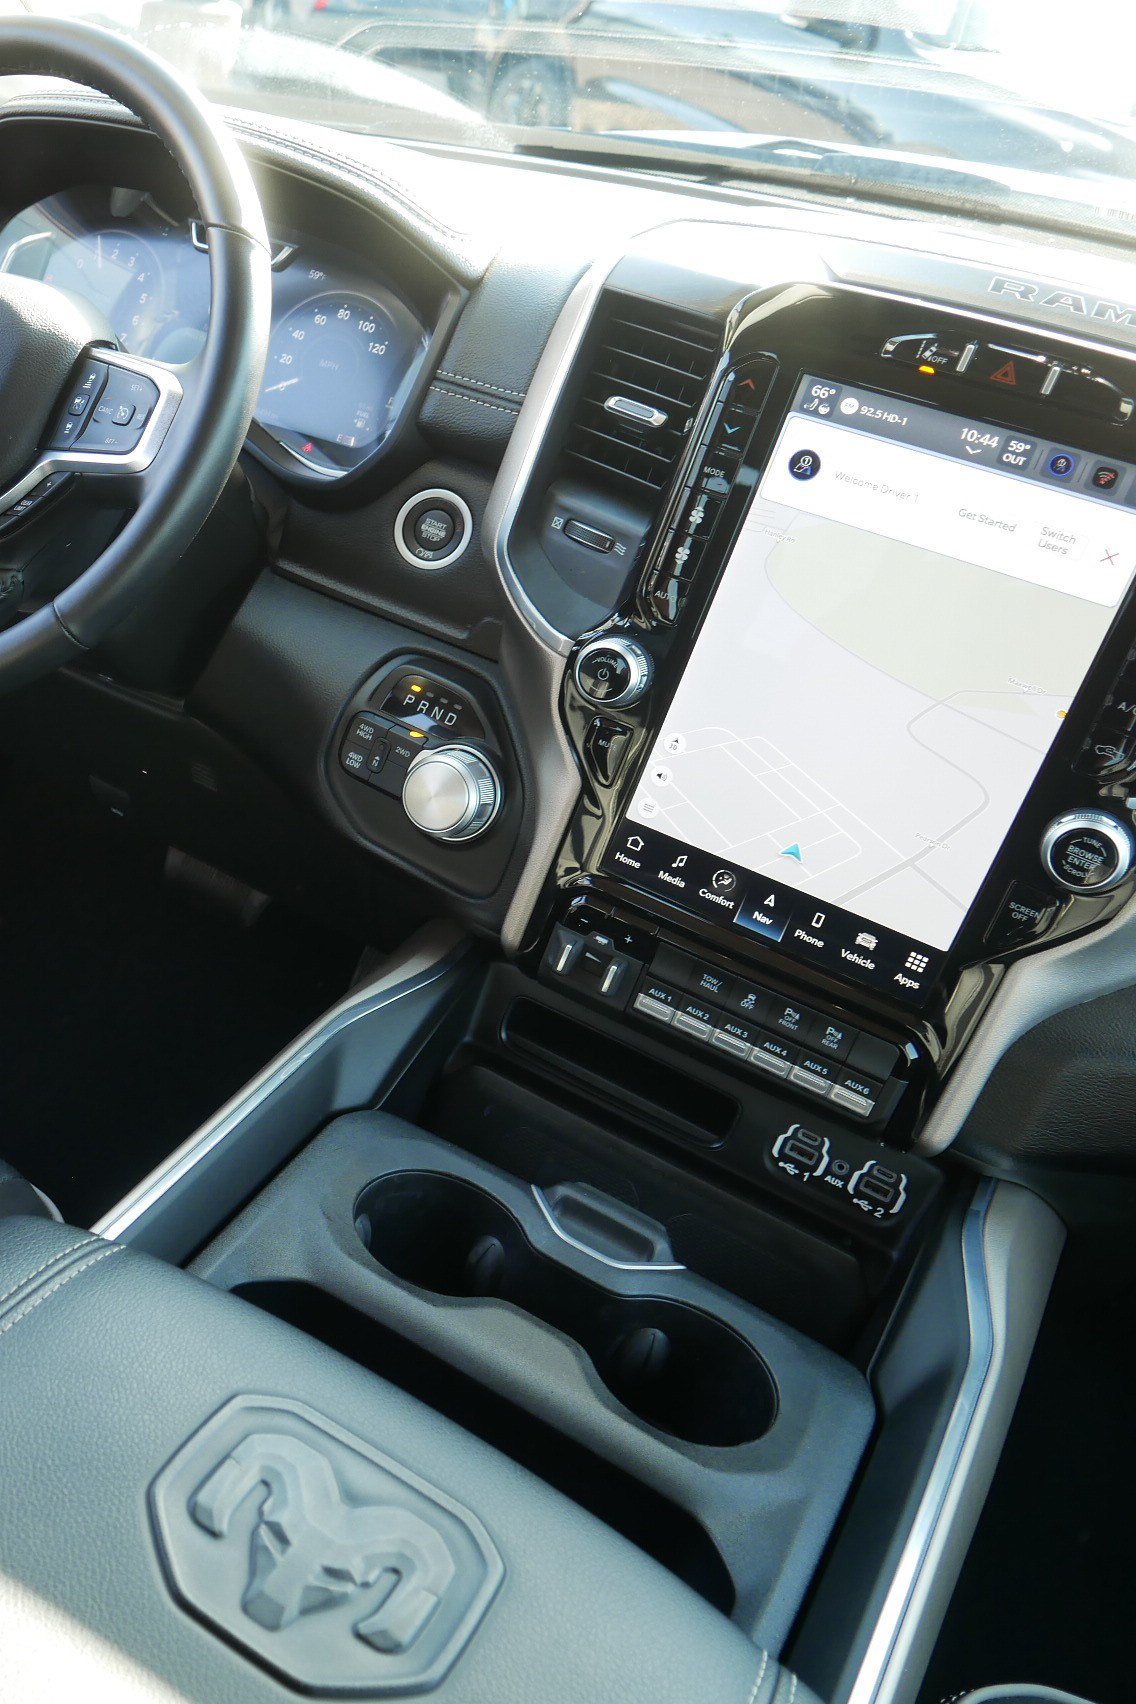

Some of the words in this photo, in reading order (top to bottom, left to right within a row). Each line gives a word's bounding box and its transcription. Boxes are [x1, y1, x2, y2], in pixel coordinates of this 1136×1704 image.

[111, 249, 120, 261] 2
[127, 256, 136, 268] 3
[137, 272, 146, 283] 4
[138, 293, 148, 304] 5
[987, 275, 1136, 328] RAM
[313, 314, 327, 326] 60
[336, 309, 351, 321] 80
[357, 320, 376, 334] 100
[291, 329, 306, 341] 40
[367, 341, 386, 356] 120
[279, 353, 293, 366] 20
[931, 354, 949, 366] OFF
[859, 405, 883, 420] 92.5
[882, 411, 909, 426] HD-1
[960, 427, 1000, 448] 10:44
[1002, 453, 1028, 466] OUT
[702, 465, 726, 478] MODE
[834, 471, 879, 492] Welcome
[880, 484, 911, 501] Driver
[424, 517, 448, 530] START
[958, 507, 977, 522] Get
[977, 513, 1017, 533] Started
[420, 523, 447, 539] ENGINE
[421, 531, 441, 542] STOP
[1040, 526, 1077, 545] Switch
[1037, 538, 1069, 555] Users
[402, 694, 416, 706] P
[416, 700, 430, 714] R
[430, 706, 445, 721] N
[444, 712, 458, 726] D
[356, 728, 373, 741] HIGH
[359, 723, 375, 734] 4WD
[348, 750, 363, 763] 4WD
[394, 745, 411, 758] 2WD
[345, 757, 362, 769] LOW
[1082, 836, 1103, 849] TUNE
[614, 851, 641, 869] Home
[1067, 844, 1105, 864] BROWSE
[1067, 855, 1097, 870] ENTER
[657, 870, 686, 888] Media
[698, 888, 735, 910] Comfort
[1008, 901, 1042, 920] SCREEN
[1011, 911, 1029, 923] OFF
[752, 910, 774, 926] Nav
[794, 928, 825, 949] Phone
[840, 948, 876, 971] Vehicle
[699, 980, 720, 993] HAUL
[893, 973, 921, 991] Apps
[648, 988, 668, 1000] AUX
[740, 999, 756, 1010] OFF
[686, 1006, 705, 1019] AUX
[703, 1013, 710, 1021] 2
[784, 1014, 797, 1024] OFF
[724, 1023, 743, 1037] AUX
[741, 1031, 749, 1039] 3
[778, 1018, 799, 1031] FRONT
[821, 1038, 839, 1050] REAR
[825, 1033, 838, 1043] OFF
[763, 1041, 782, 1055] AUX
[781, 1049, 788, 1057] 4
[803, 1060, 823, 1074] AUX
[822, 1068, 829, 1076] 5
[844, 1079, 864, 1093] AUX
[862, 1087, 870, 1096] 6
[802, 1172, 810, 1182] 1
[823, 1174, 845, 1189] AUX
[873, 1207, 885, 1219] 2
